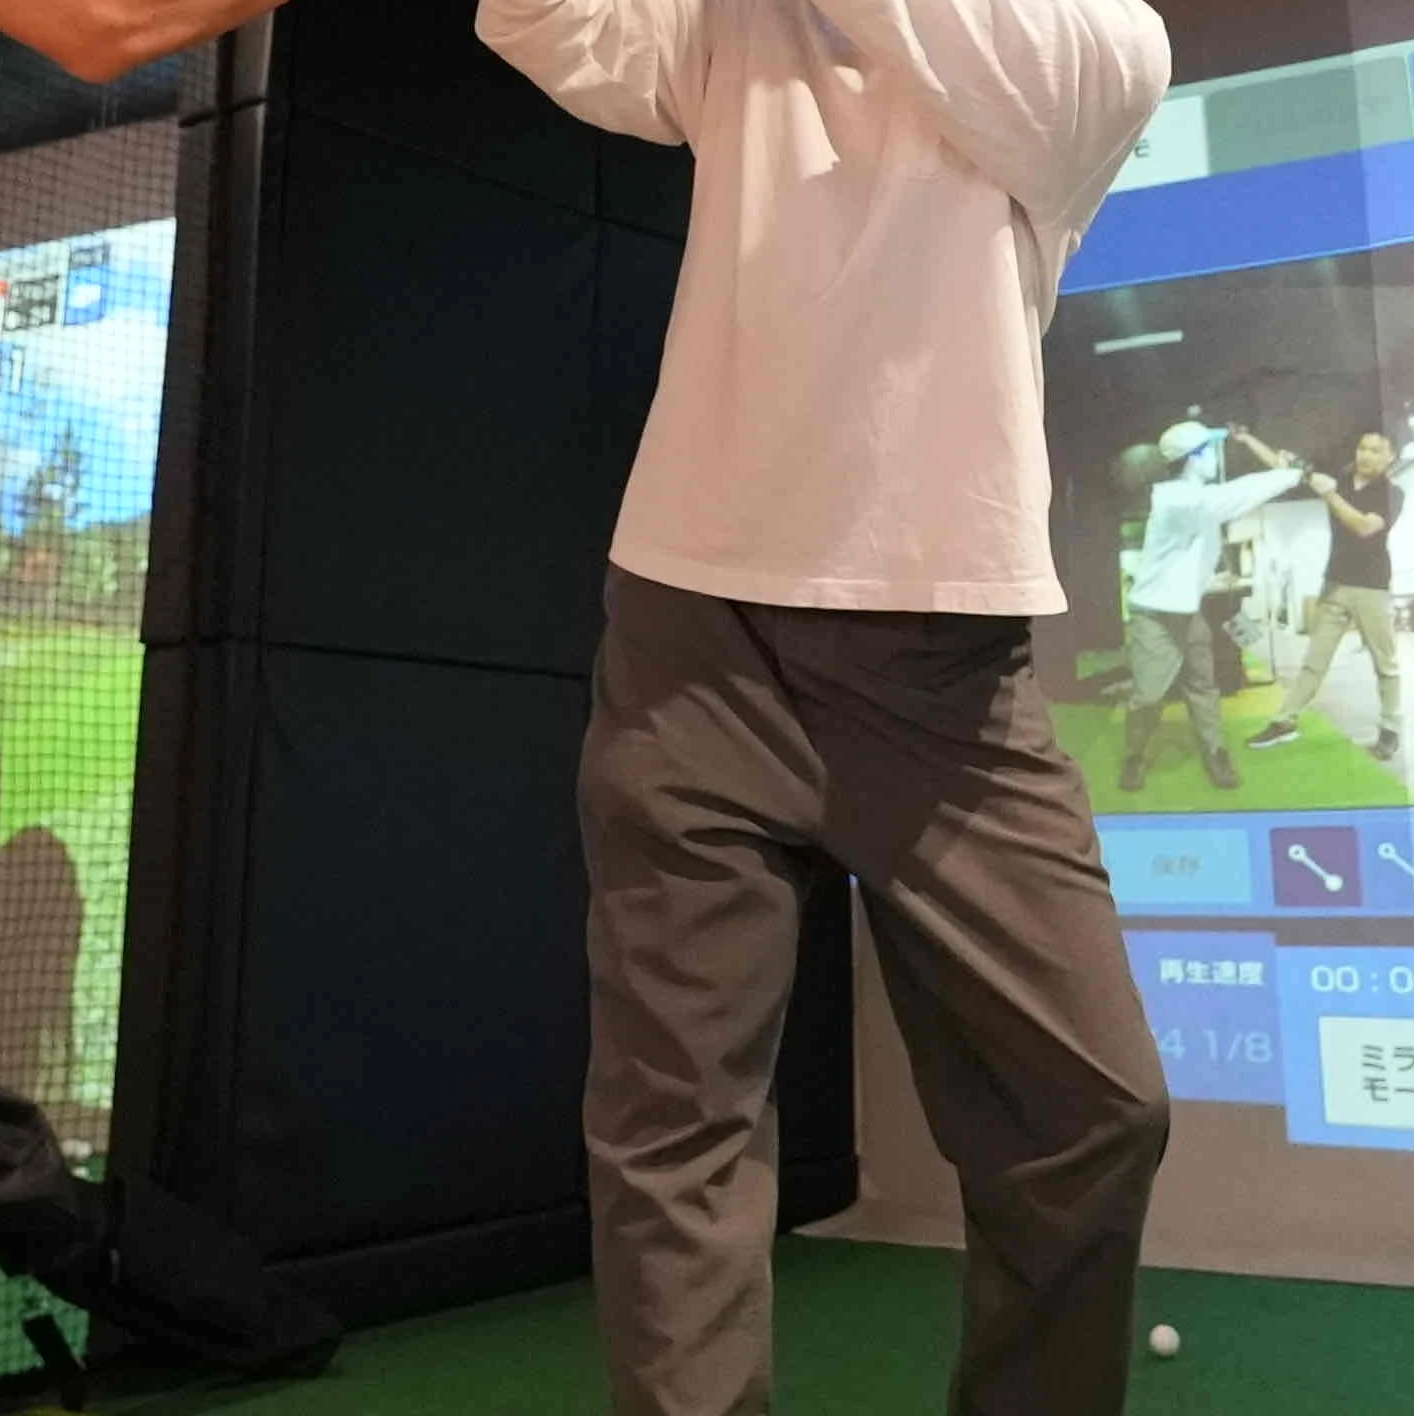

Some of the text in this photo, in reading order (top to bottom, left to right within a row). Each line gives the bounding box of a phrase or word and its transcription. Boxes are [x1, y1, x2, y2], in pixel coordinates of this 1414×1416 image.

[1159, 958, 1266, 986] 再生速度
[1203, 1030, 1274, 1063] 1/8
